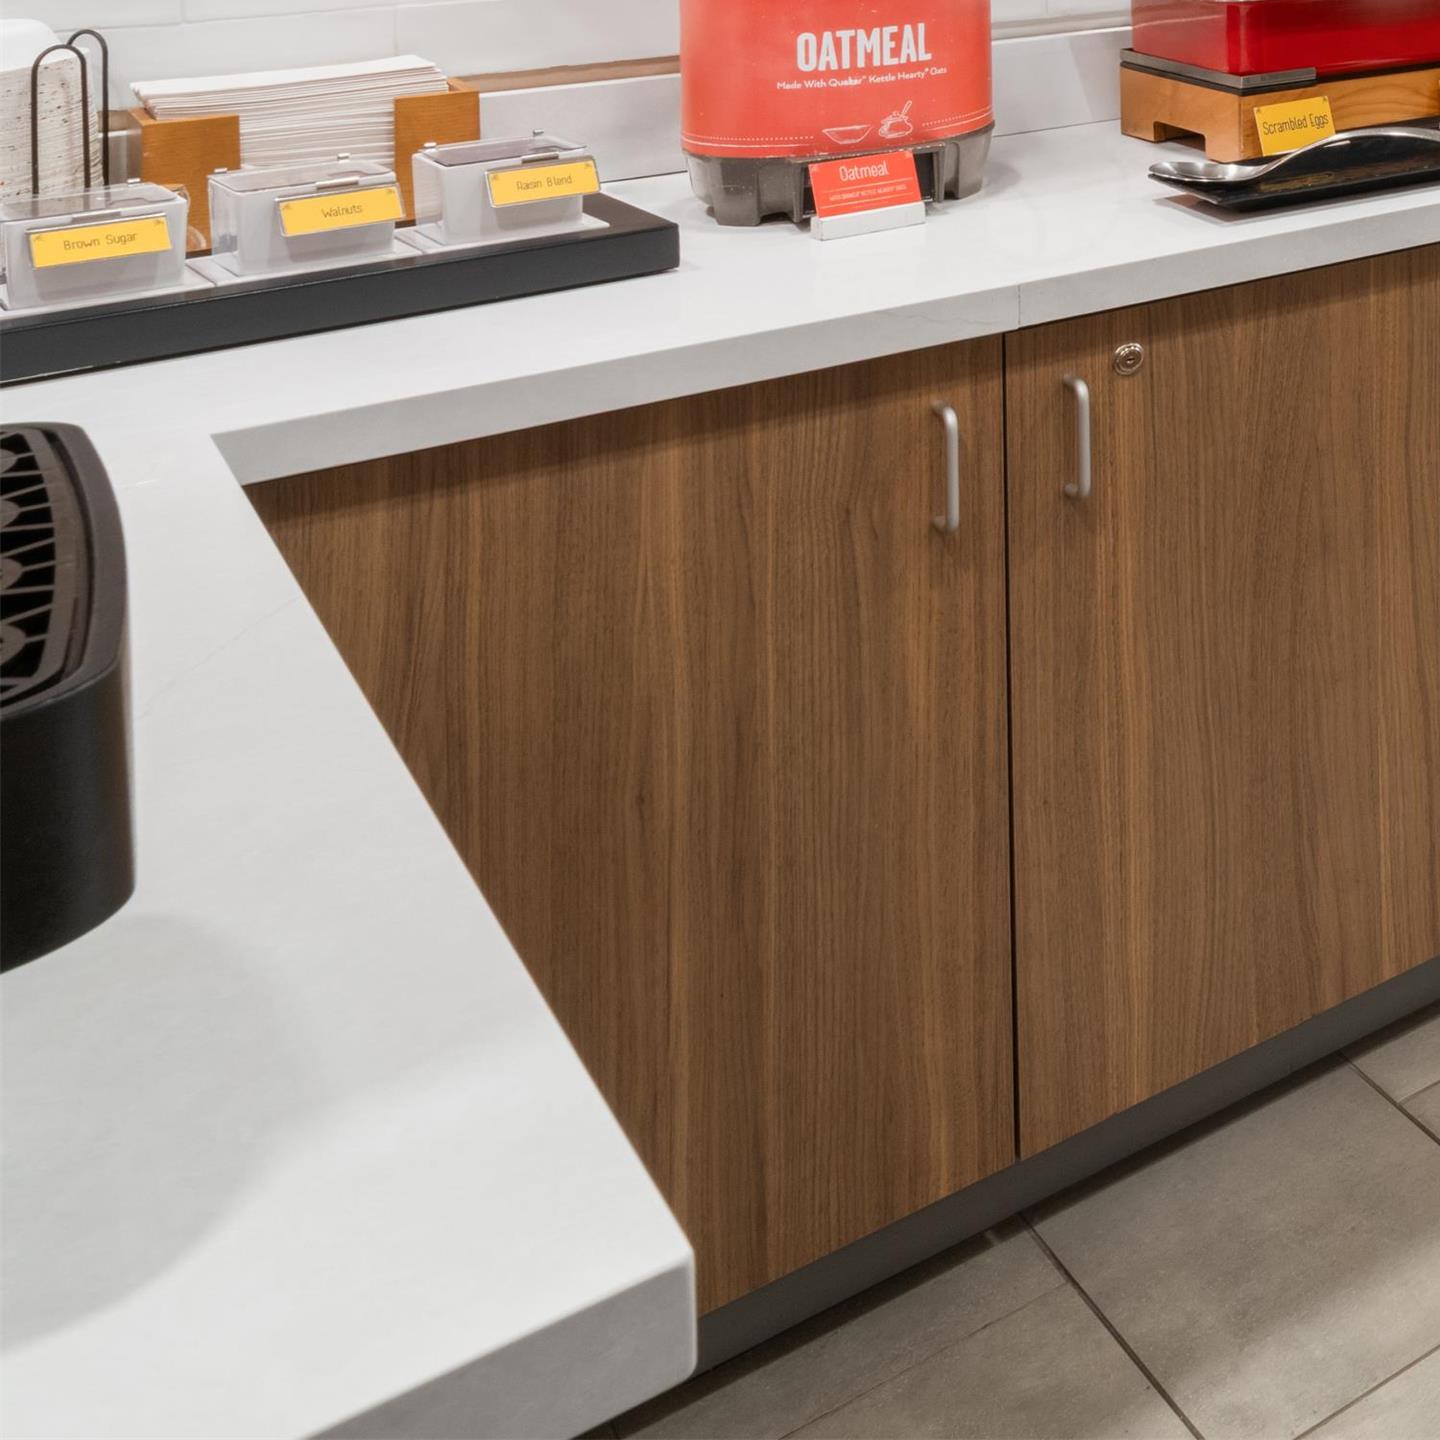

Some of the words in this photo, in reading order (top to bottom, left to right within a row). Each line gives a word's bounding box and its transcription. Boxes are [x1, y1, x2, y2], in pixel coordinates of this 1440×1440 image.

[796, 22, 933, 73] OATMEAL
[777, 81, 801, 90] Made
[804, 79, 827, 89] With
[868, 74, 896, 84] Kettle
[1262, 114, 1308, 135] Scrambled
[1309, 113, 1329, 129] Eggs
[839, 160, 889, 182] Oatmeal
[546, 175, 573, 187] Blend
[321, 205, 363, 218] Walnuts
[63, 240, 101, 251] Brown
[105, 232, 138, 246] Sugar
